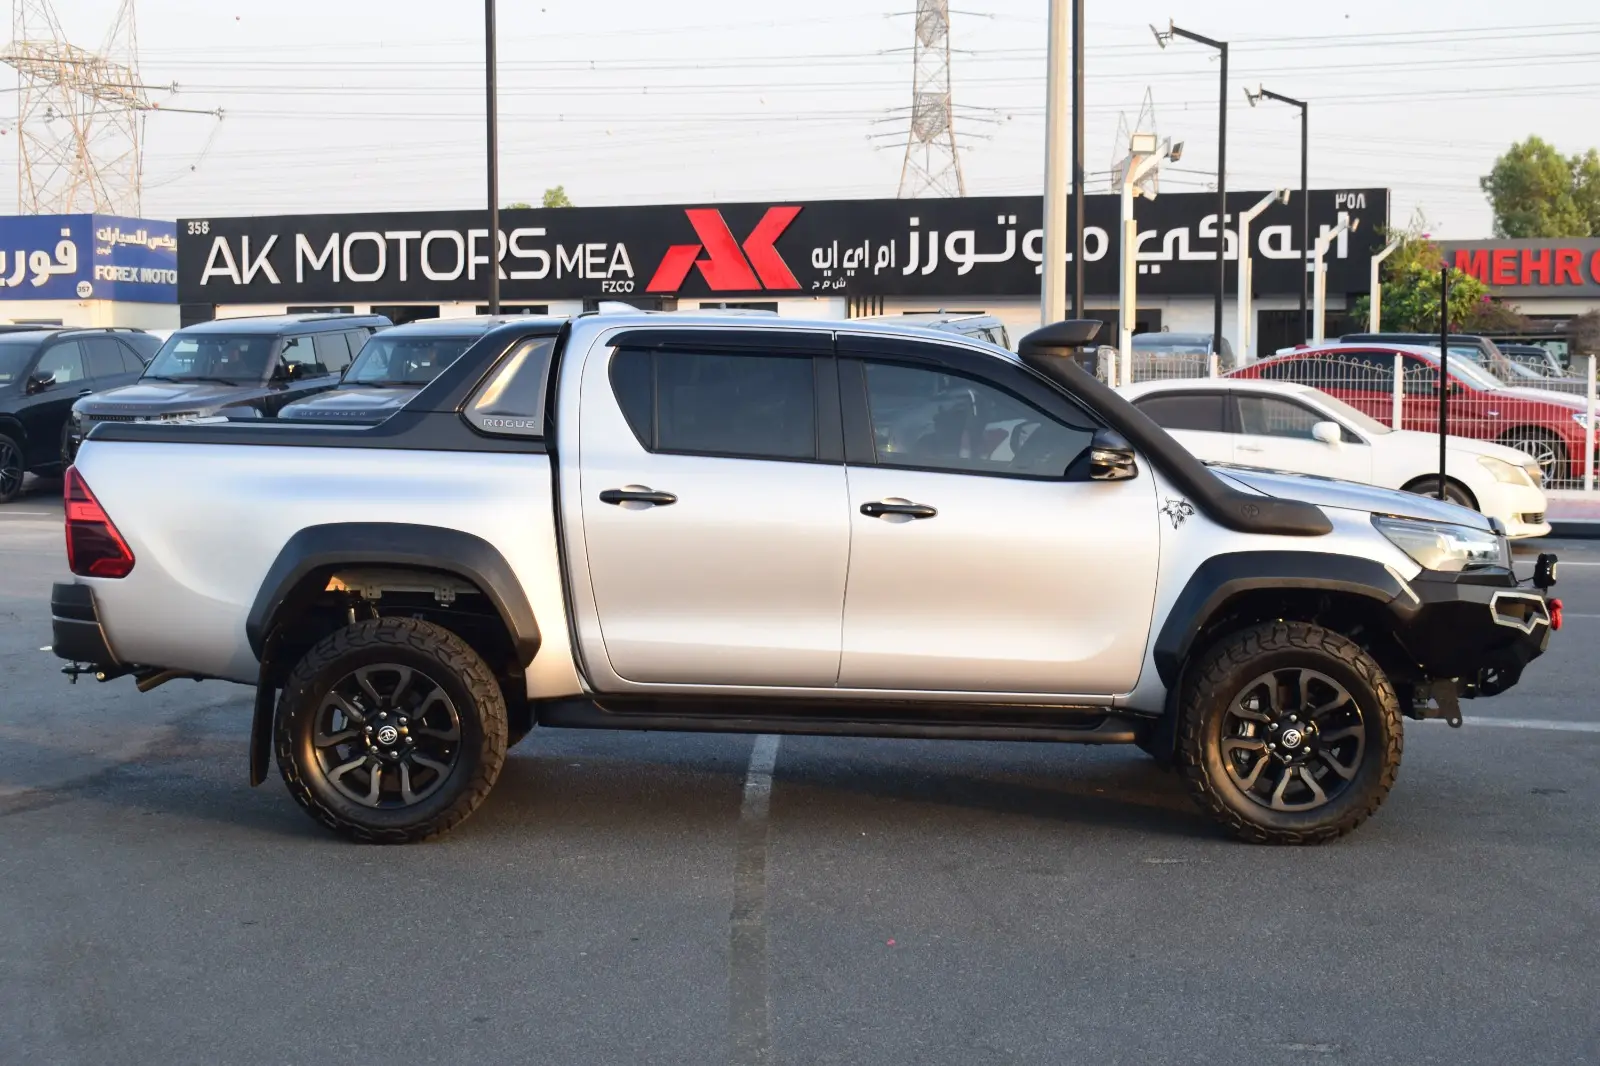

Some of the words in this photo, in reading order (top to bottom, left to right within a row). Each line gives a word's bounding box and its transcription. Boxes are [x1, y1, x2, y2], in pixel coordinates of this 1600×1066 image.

[1335, 193, 1366, 209] ٣٥٨
[187, 221, 210, 235] 358
[645, 206, 803, 292] AK
[902, 214, 1110, 276] موتورز
[199, 235, 281, 286] AK
[295, 227, 551, 284] MOTORS
[556, 243, 635, 280] MEA
[95, 265, 139, 282] FOREX
[141, 267, 177, 284] MOTO
[602, 280, 635, 293] FZCO
[483, 418, 535, 429] ROGUE
